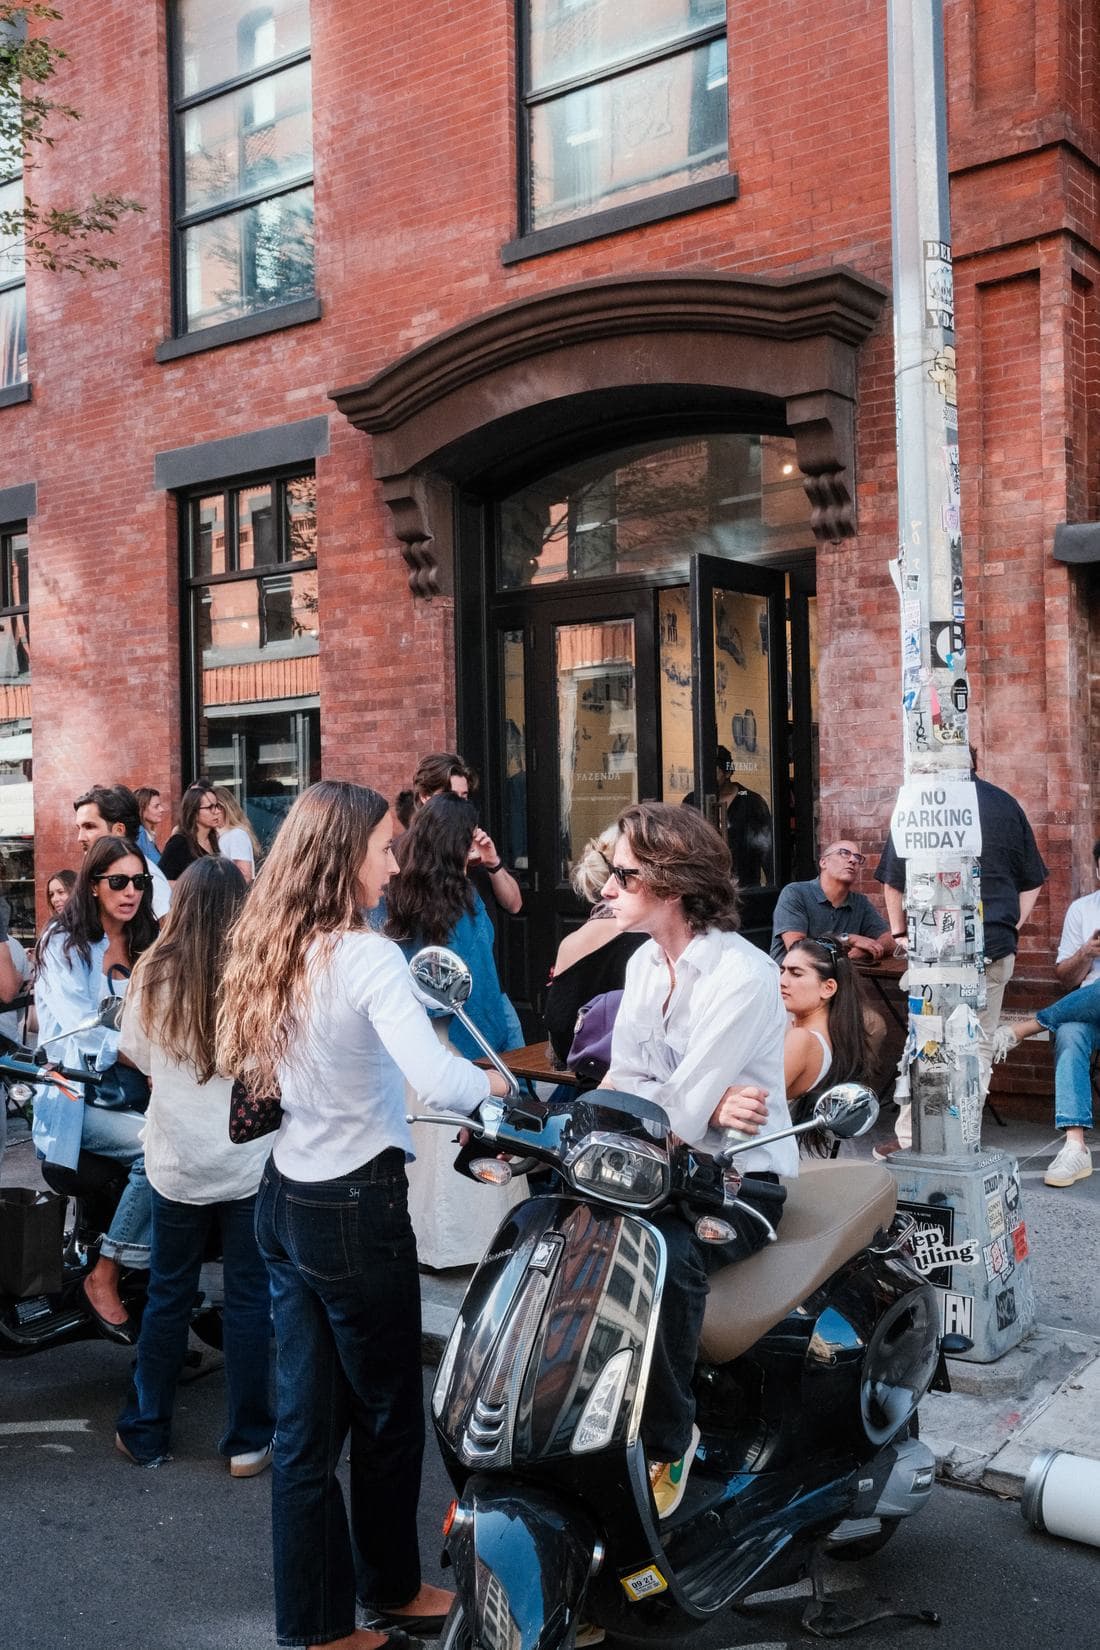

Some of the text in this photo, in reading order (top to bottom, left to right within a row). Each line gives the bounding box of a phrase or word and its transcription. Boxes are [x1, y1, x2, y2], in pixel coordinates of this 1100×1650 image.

[576, 772, 621, 781] FAZENDA
[920, 788, 946, 806] NO
[897, 808, 973, 828] PARKING
[904, 830, 966, 849] FRIDAY
[911, 1233, 940, 1248] ep
